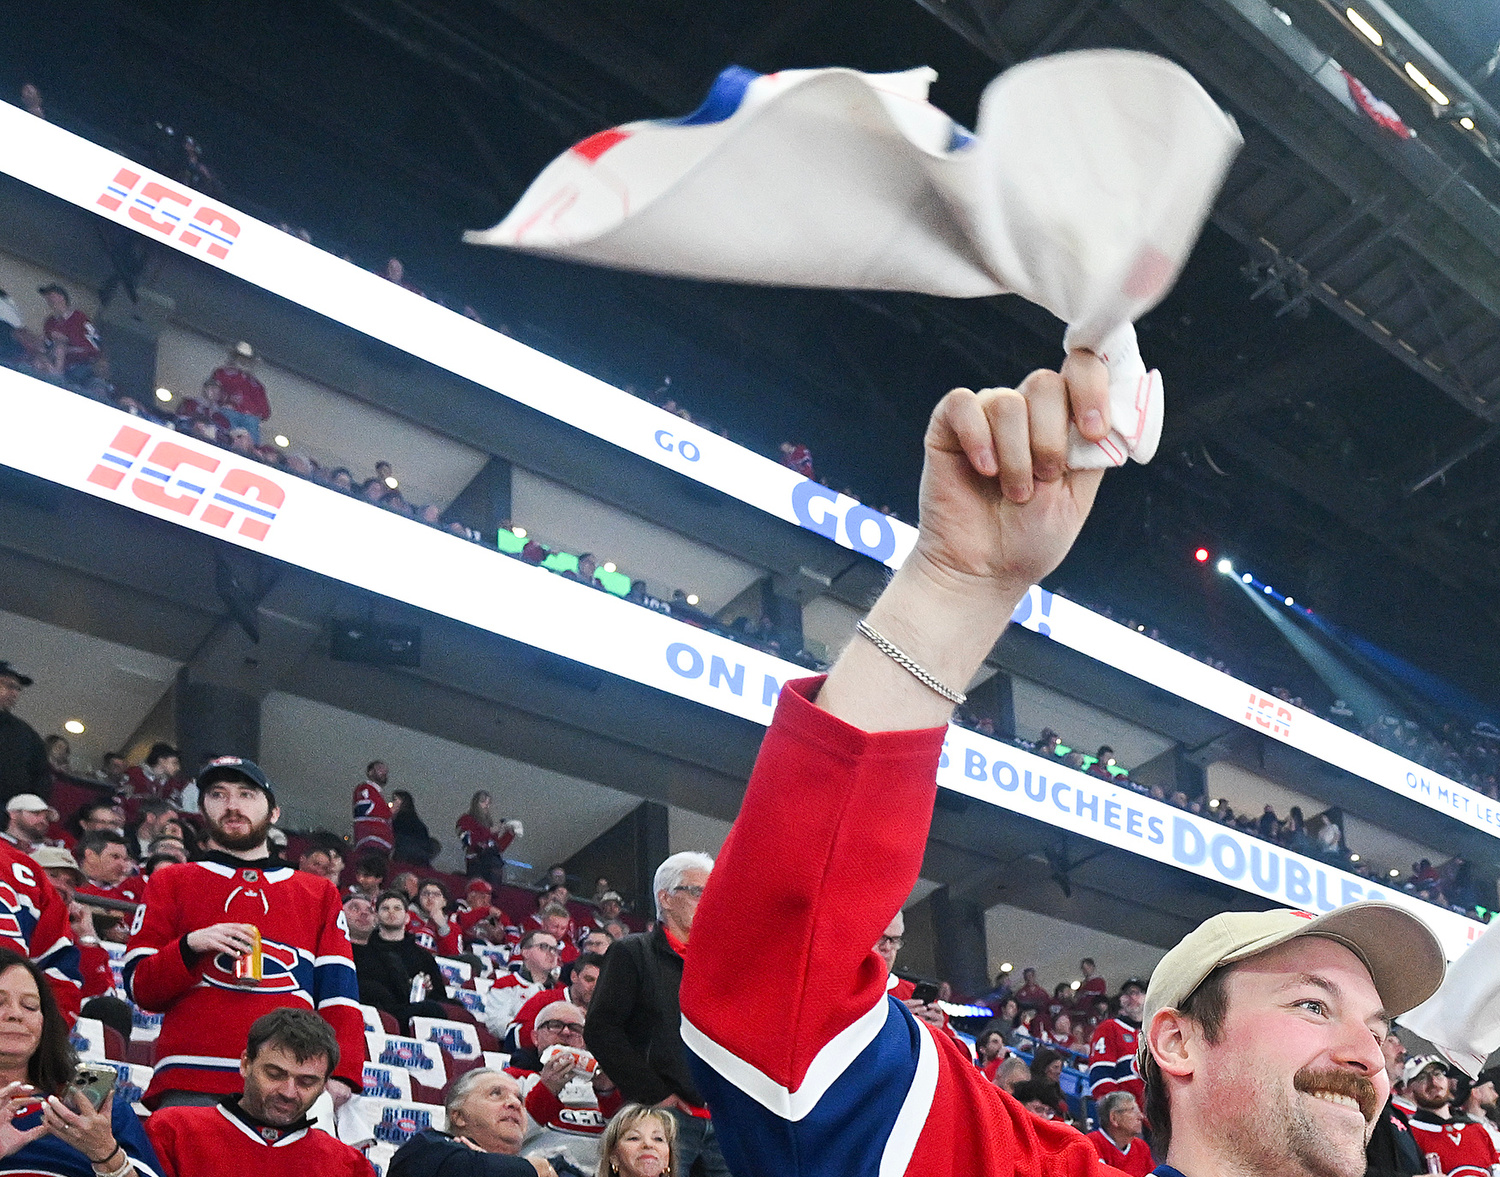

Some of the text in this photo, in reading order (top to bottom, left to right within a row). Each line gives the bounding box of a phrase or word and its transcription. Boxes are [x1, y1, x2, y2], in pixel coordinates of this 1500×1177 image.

[96, 167, 241, 260] IGA
[654, 430, 701, 462] GO
[86, 425, 287, 542] IGA
[791, 478, 897, 564] GO
[665, 641, 746, 697] ON
[1245, 694, 1292, 737] IGA
[1406, 772, 1431, 795] ON
[1438, 786, 1470, 813] MET
[963, 747, 1386, 912] BOUCHÉES DOUBLE
